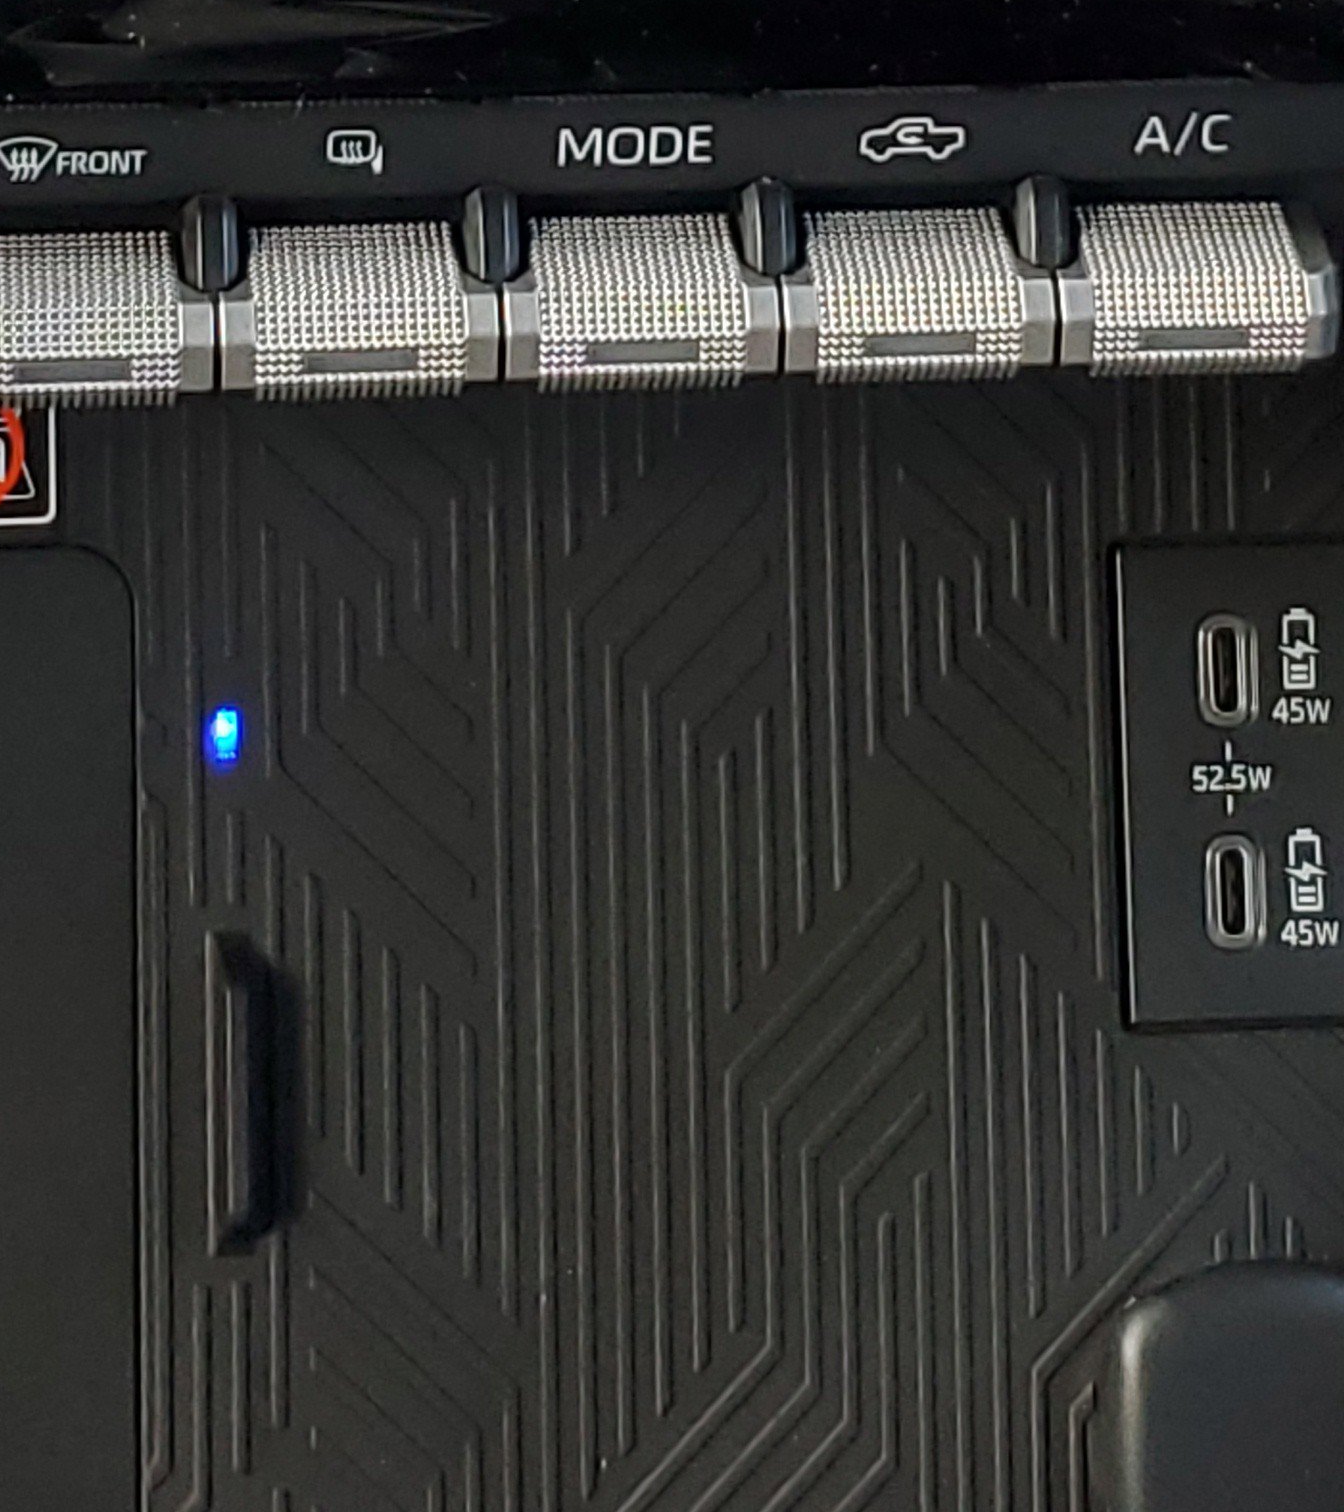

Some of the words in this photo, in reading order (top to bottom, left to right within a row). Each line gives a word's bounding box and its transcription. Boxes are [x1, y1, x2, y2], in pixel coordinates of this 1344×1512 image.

[558, 124, 714, 168] MODE
[1134, 112, 1232, 156] A/C
[57, 149, 146, 175] FRONT
[1272, 696, 1332, 725] 45W
[1192, 764, 1272, 791] 52.5W
[1281, 919, 1340, 947] 45W
